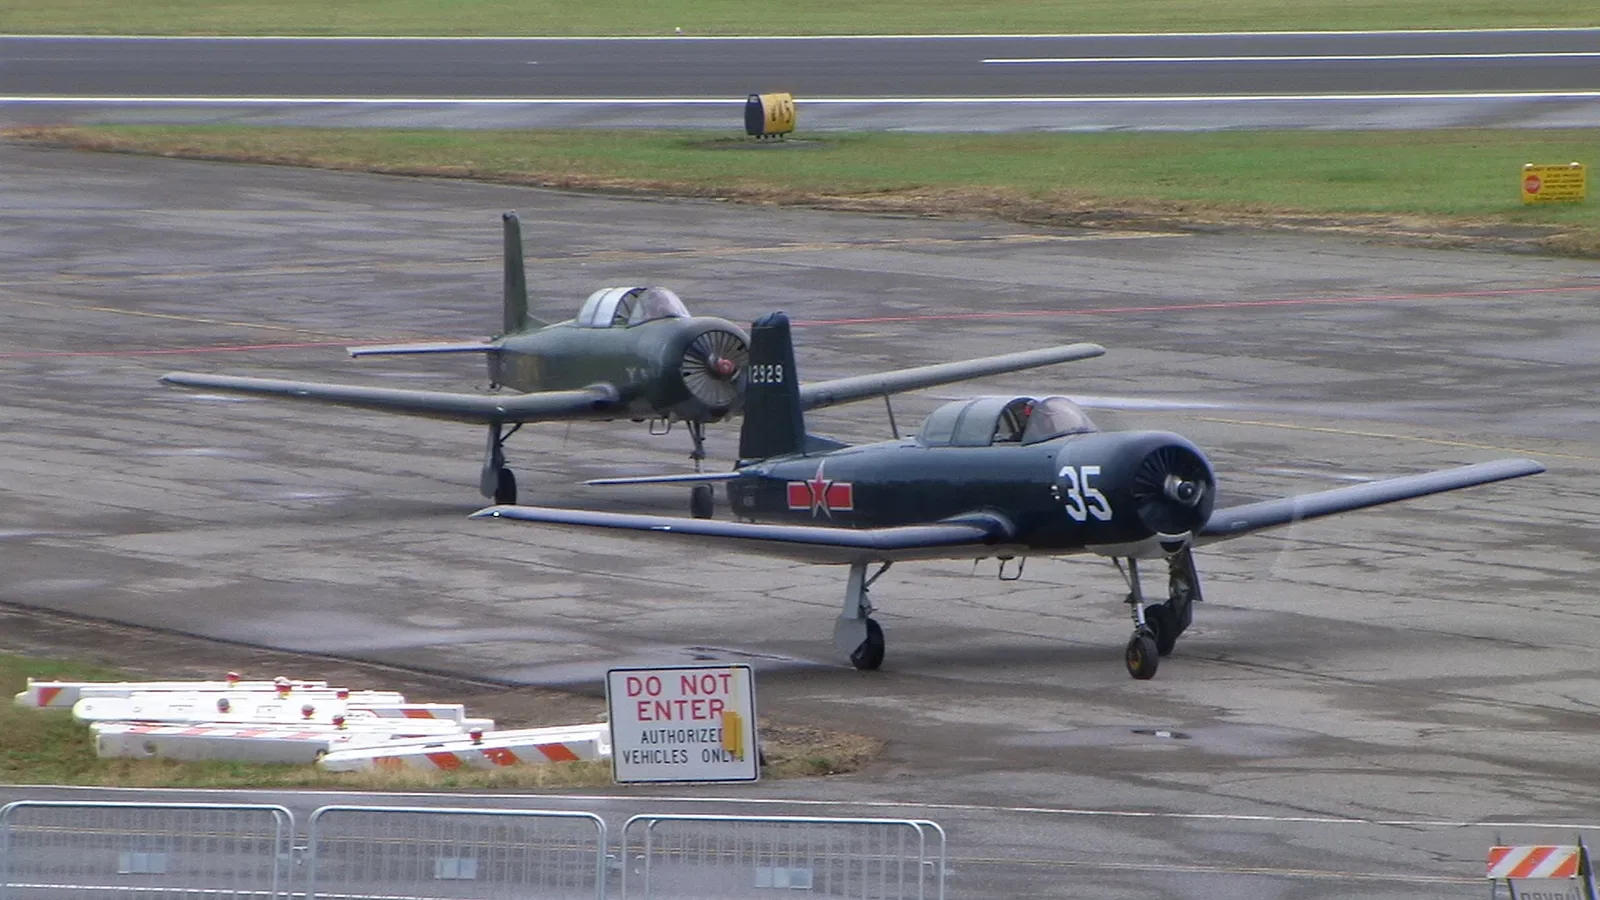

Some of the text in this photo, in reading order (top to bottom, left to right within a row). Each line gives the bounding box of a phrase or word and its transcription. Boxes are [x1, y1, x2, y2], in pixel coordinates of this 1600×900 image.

[1058, 465, 1113, 521] 35
[626, 673, 732, 697] DO NOT
[637, 699, 725, 721] ENTER
[623, 750, 689, 764] VEHICLES
